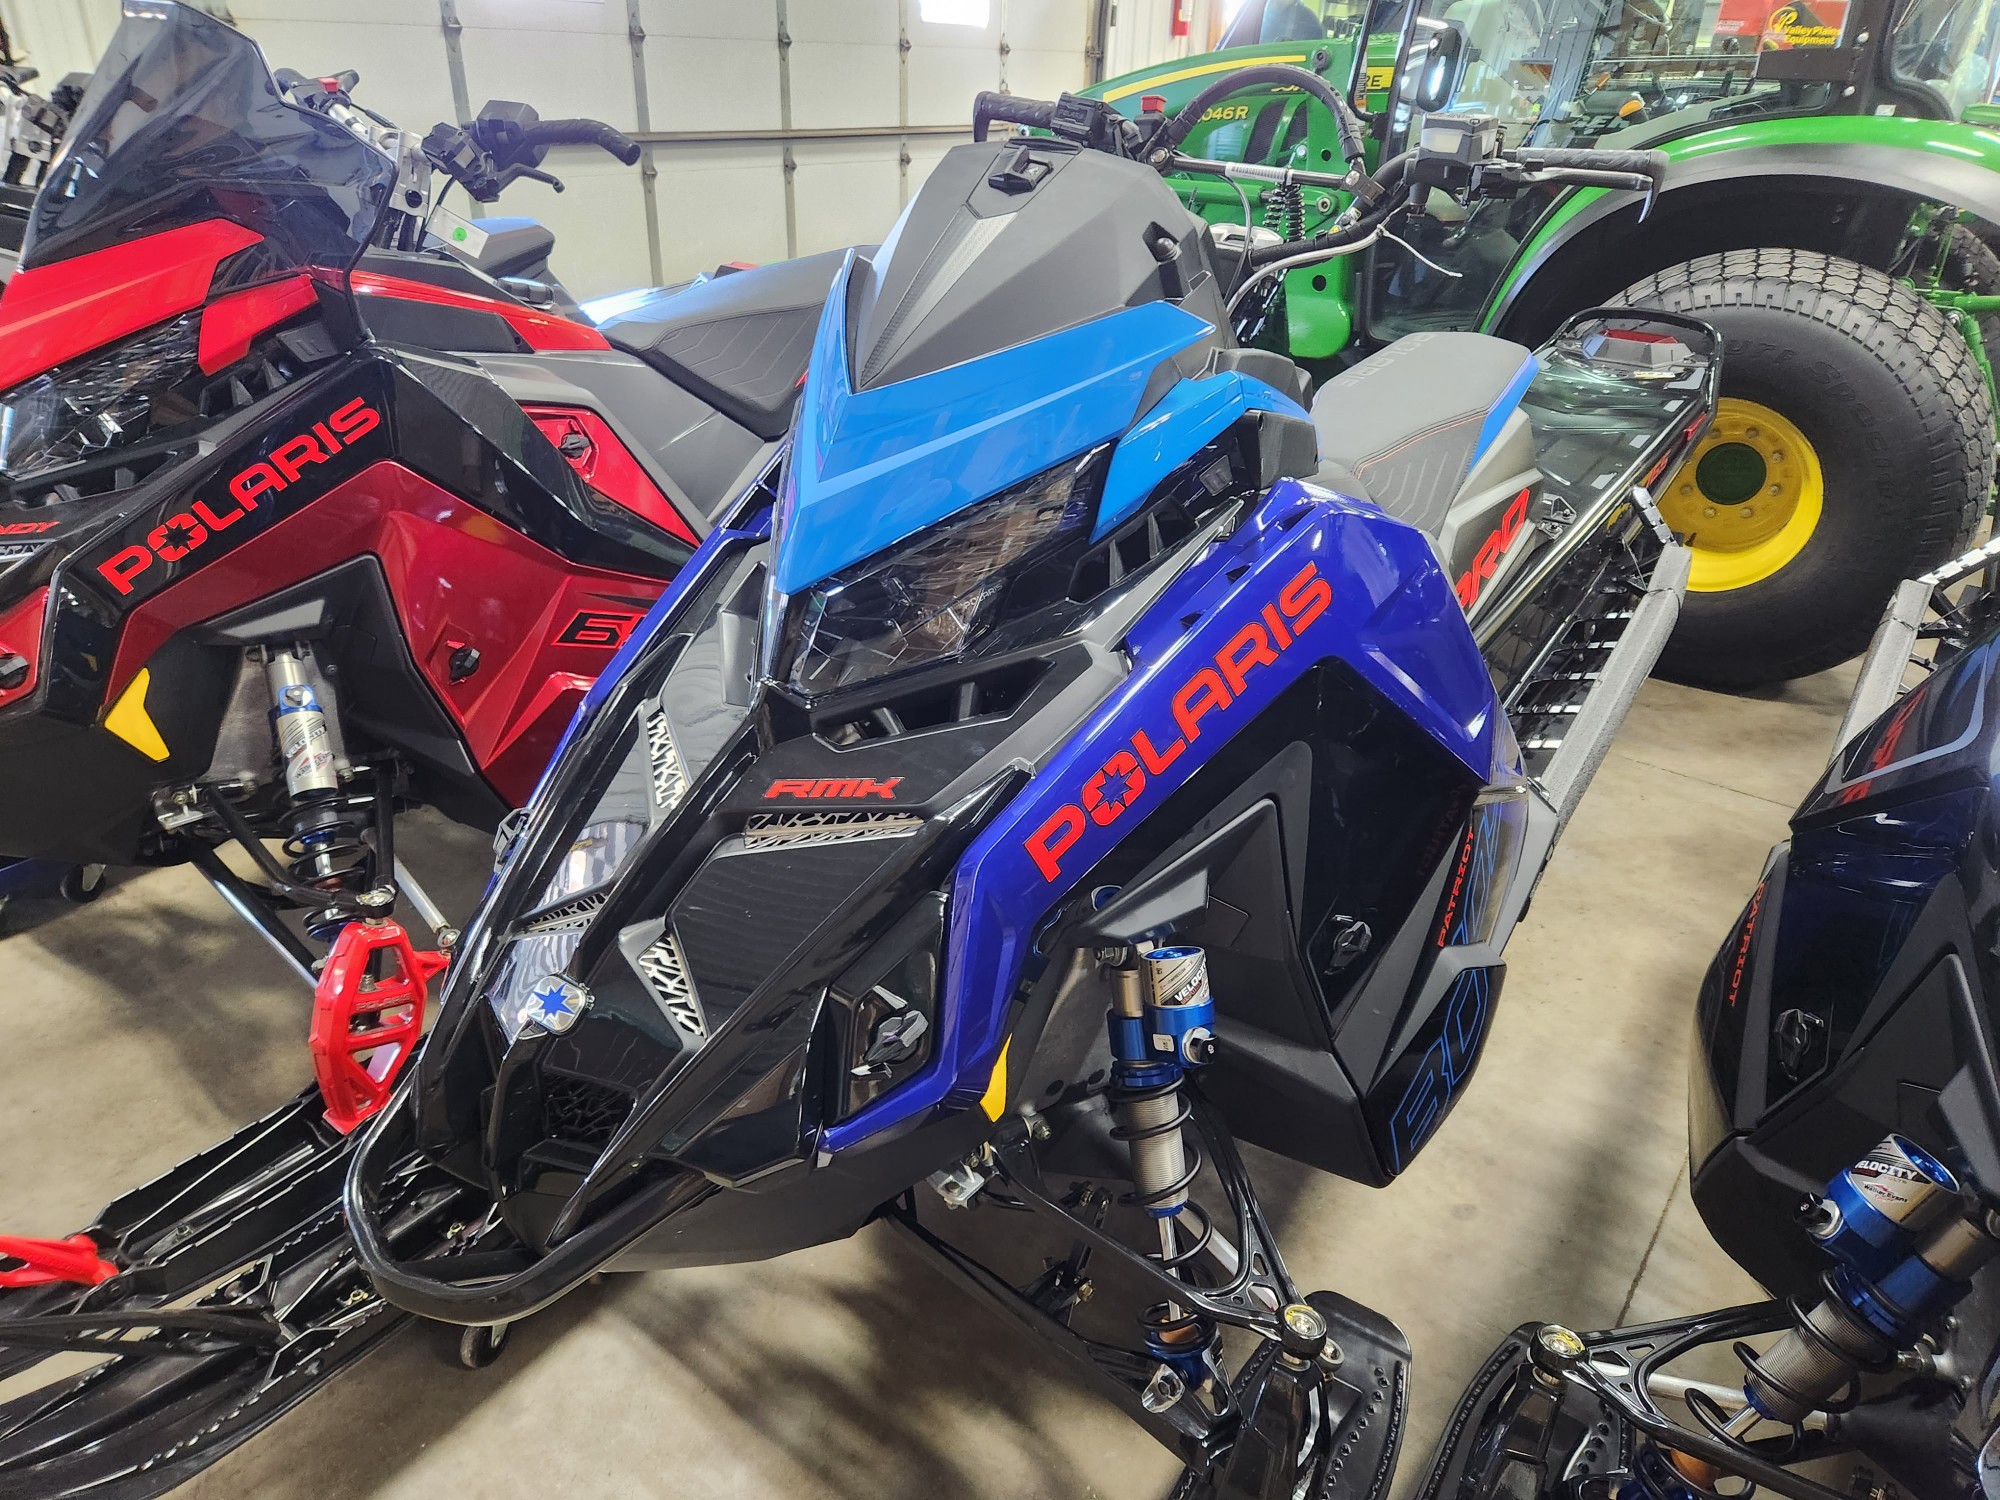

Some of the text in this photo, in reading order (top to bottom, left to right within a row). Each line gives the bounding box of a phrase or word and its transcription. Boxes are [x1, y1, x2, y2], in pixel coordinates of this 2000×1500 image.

[1783, 34, 1836, 46] Equipment
[1198, 104, 1249, 122] 046R
[0, 520, 60, 535] NDY
[97, 396, 381, 597] POLARIS
[1024, 561, 1333, 883] POLARIS
[764, 777, 905, 800] RMK
[1437, 824, 1474, 948] PATRIOT
[1728, 882, 1765, 1007] PATRIOT
